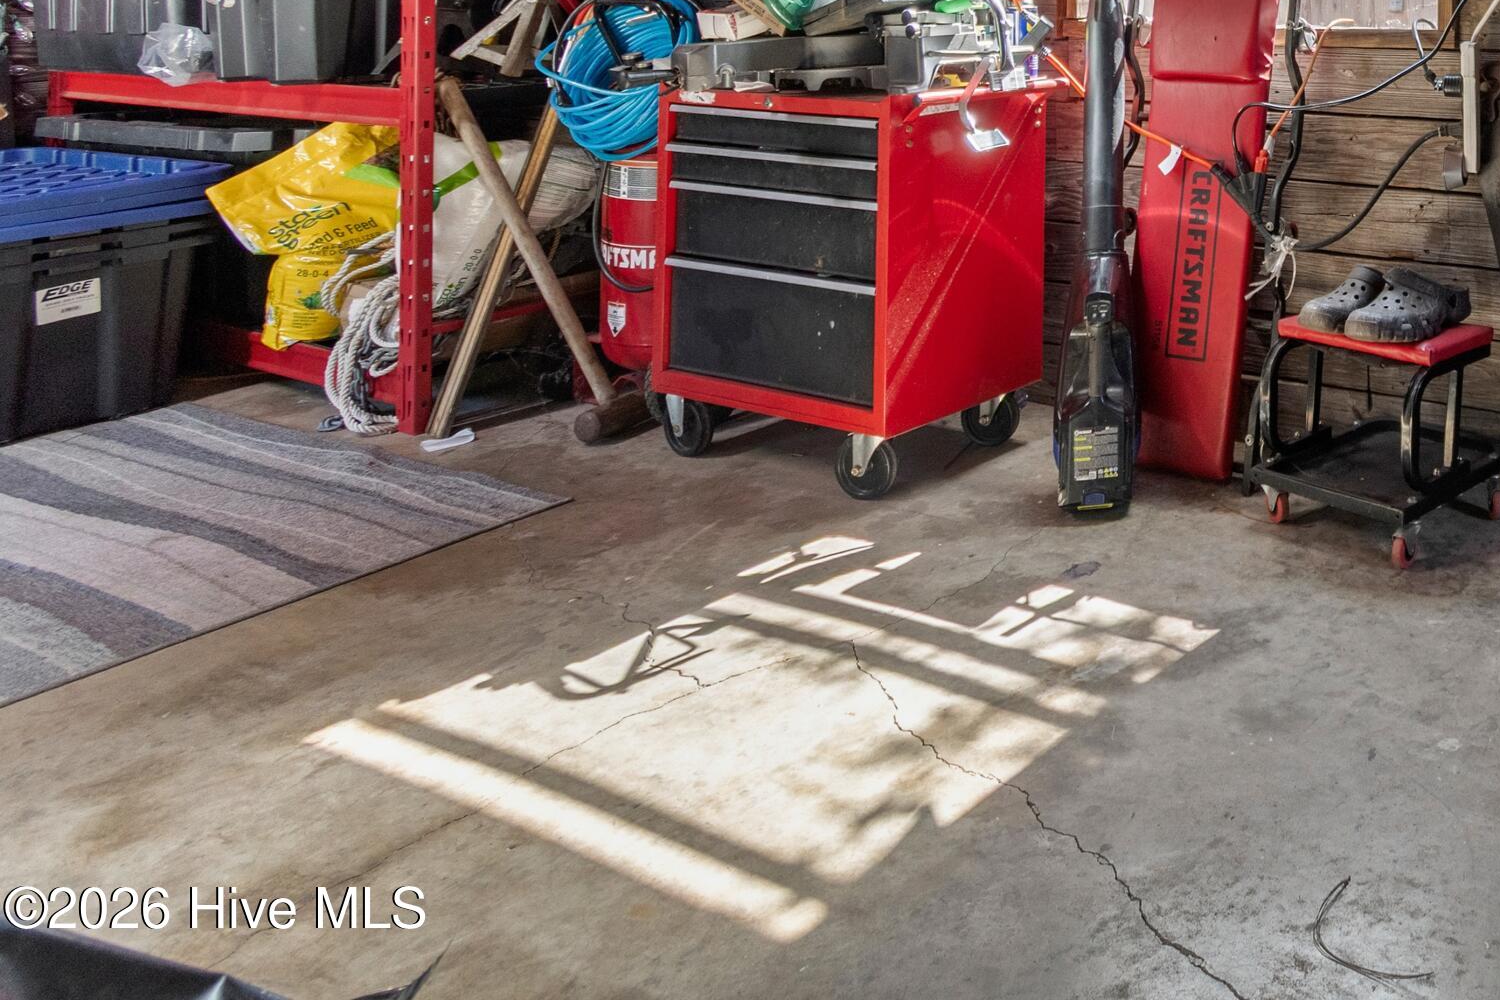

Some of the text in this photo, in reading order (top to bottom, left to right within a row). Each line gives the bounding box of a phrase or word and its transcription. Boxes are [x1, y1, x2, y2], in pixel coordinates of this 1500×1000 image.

[333, 228, 345, 238] &
[346, 217, 378, 234] Feed
[1176, 170, 1214, 348] CRAFTSMAN
[296, 268, 329, 278] 28-0-4
[41, 280, 93, 303] EDGE
